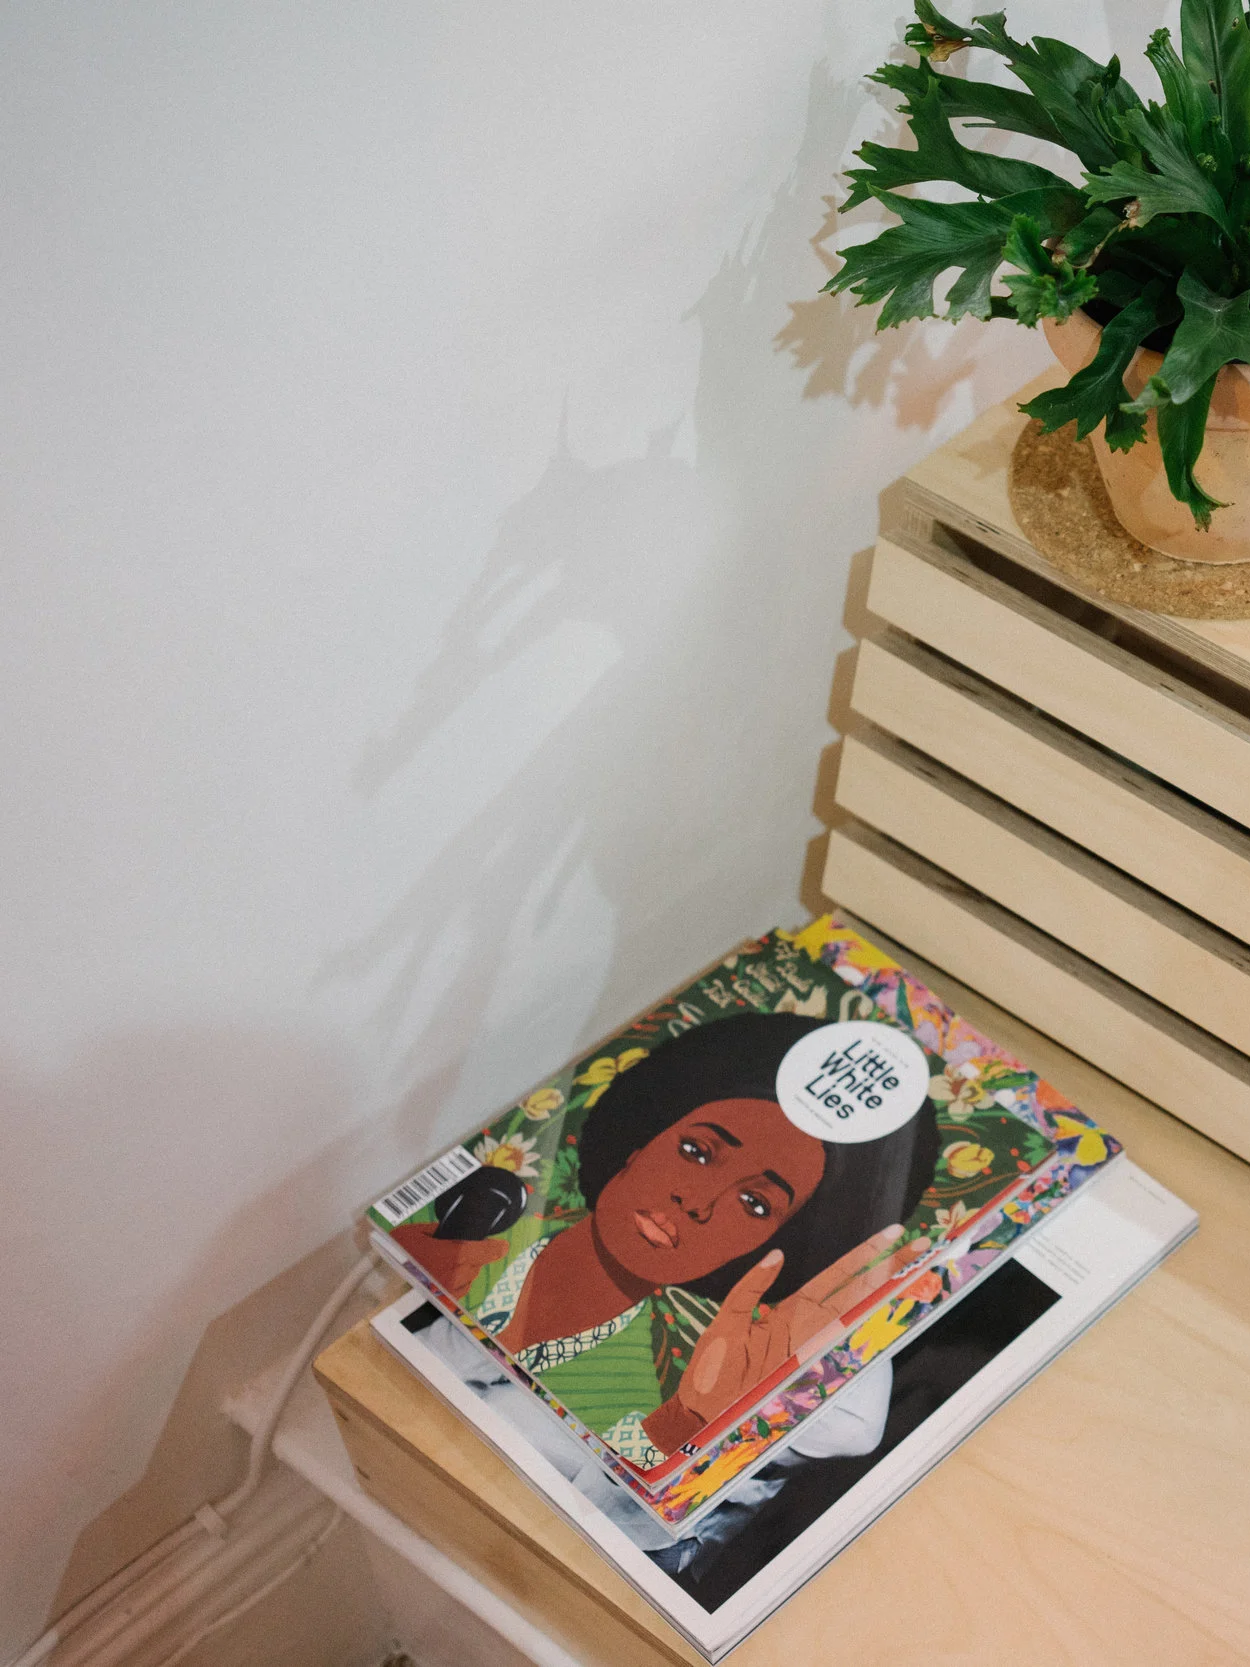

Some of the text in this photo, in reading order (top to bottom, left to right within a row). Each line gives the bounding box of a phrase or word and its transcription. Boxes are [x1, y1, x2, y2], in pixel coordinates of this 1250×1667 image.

[820, 1051, 882, 1109] White
[843, 1039, 899, 1090] Little
[805, 1073, 854, 1119] Lies
